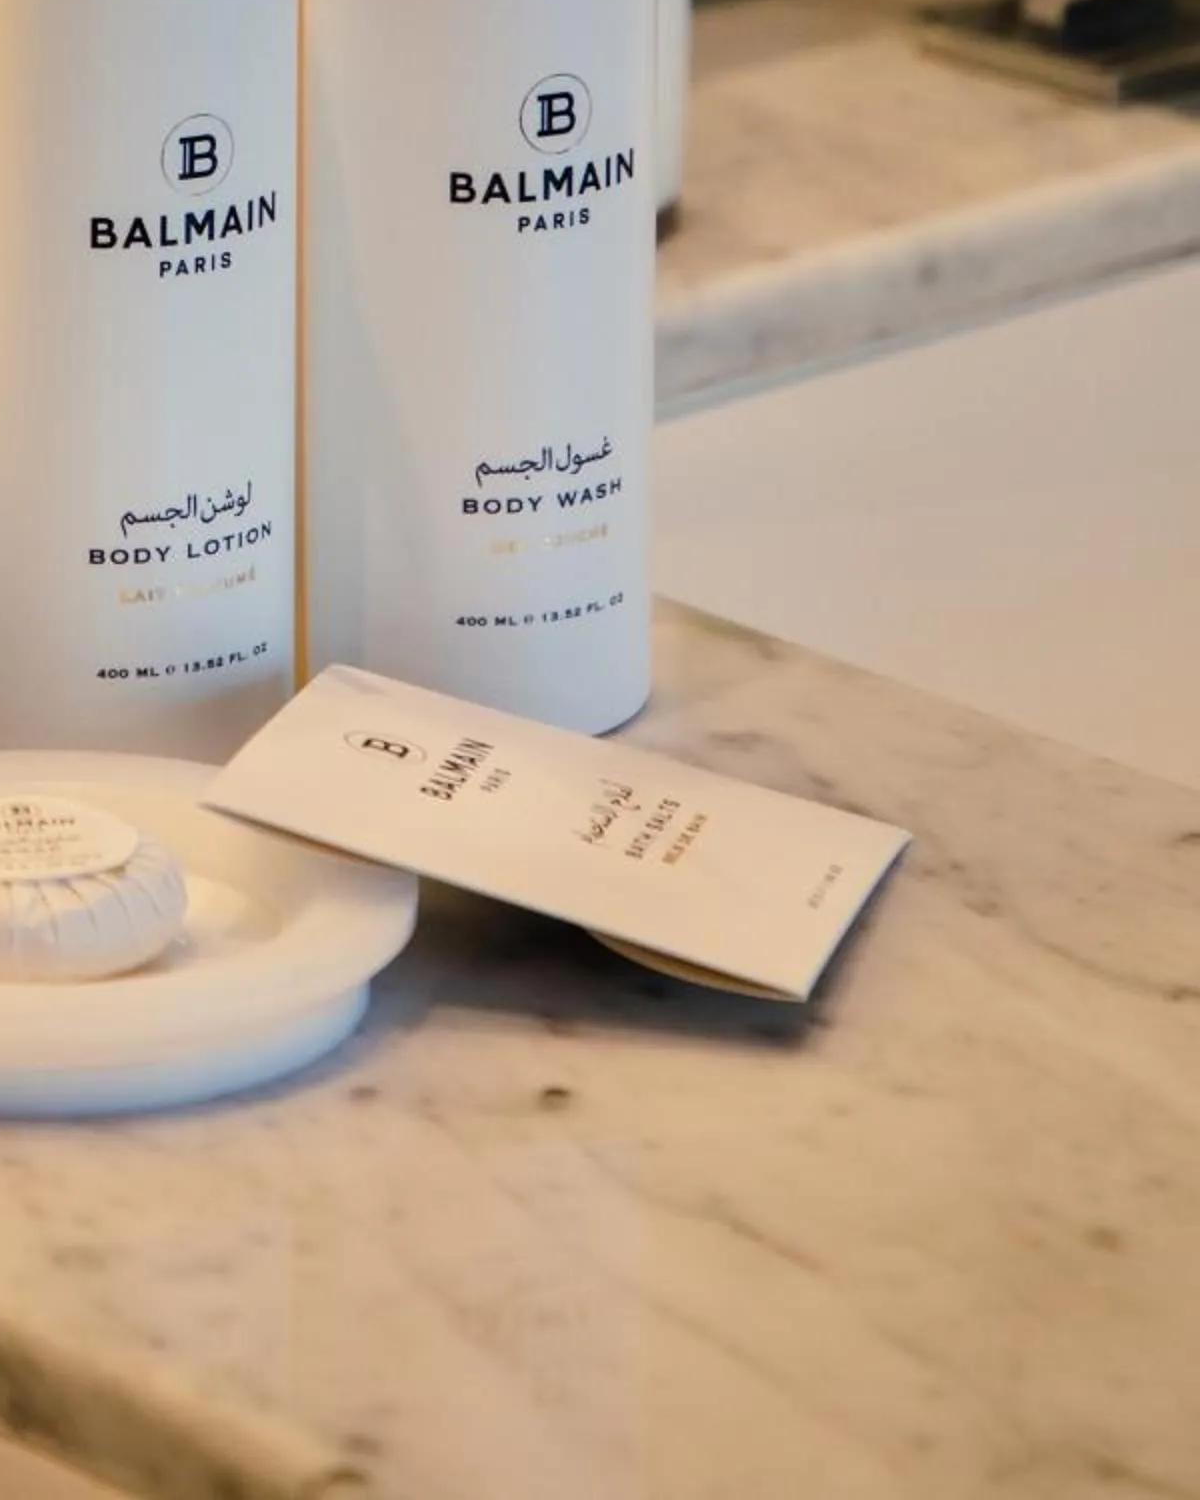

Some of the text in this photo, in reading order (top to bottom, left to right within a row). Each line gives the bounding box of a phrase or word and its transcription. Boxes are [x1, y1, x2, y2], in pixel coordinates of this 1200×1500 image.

[537, 91, 576, 138] B
[178, 133, 218, 181] B
[449, 147, 635, 204] BALMAIN
[89, 190, 277, 249] BALMAIN
[517, 207, 591, 233] PARIS
[159, 251, 233, 278] PARIS
[475, 436, 612, 488] غسول الجسم
[119, 479, 253, 538] لوشن الجسم
[462, 477, 622, 514] BODY WASH
[88, 521, 273, 565] BODY LOTION
[456, 616, 488, 627] 400
[494, 615, 518, 627] ML
[96, 668, 129, 679] 400
[135, 667, 160, 678] ML
[420, 737, 494, 801] BALMAIN
